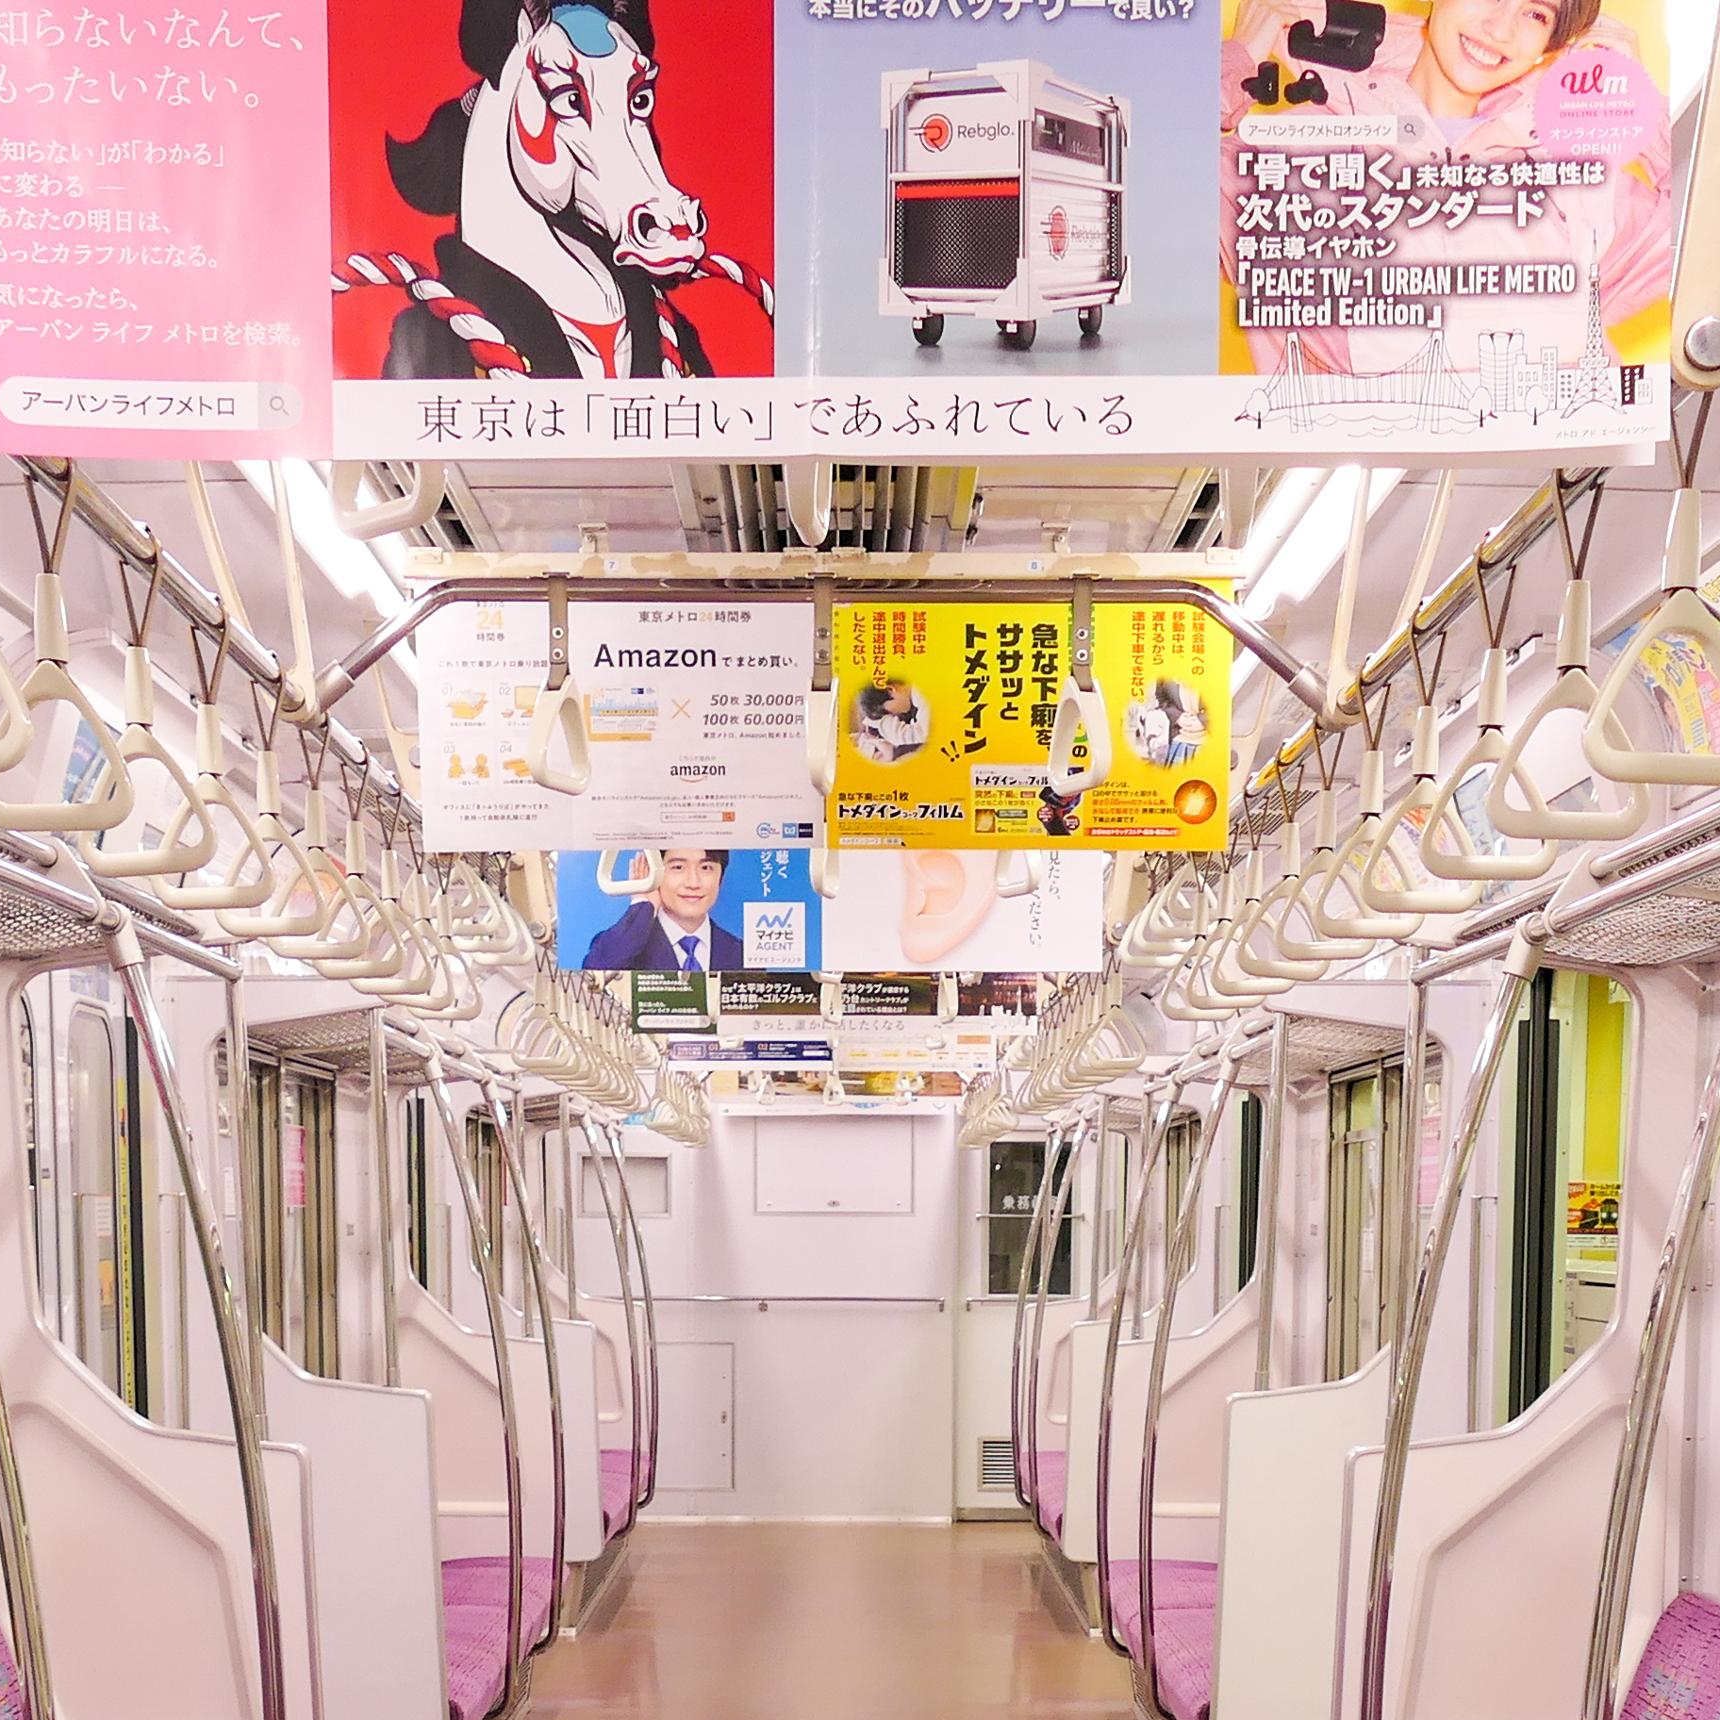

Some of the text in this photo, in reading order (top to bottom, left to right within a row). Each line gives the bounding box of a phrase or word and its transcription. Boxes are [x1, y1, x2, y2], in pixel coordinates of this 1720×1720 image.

[957, 123, 1015, 141] Rebglo.
[1248, 122, 1392, 137] アーバンライフメトロオンライン
[1549, 125, 1643, 140] オンラインストア
[1236, 190, 1547, 232] 次代のスタンダード
[1236, 235, 1397, 261] 骨伝導イヤホン
[1319, 266, 1374, 296] TW-1
[1381, 265, 1451, 295] URBAN
[1456, 264, 1499, 294] LIFE
[1504, 263, 1576, 294] METRO
[1238, 297, 1332, 328] Limited
[92, 321, 154, 344] ライフ
[162, 320, 303, 347] メトロを検索。
[22, 390, 236, 416] アーバンライフメトロ
[476, 609, 505, 631] 24
[912, 610, 927, 655] 試験中は
[1151, 610, 1166, 666] 遅れるから
[593, 643, 717, 668] Amazon
[670, 764, 726, 777] amazon
[755, 929, 794, 941] マイナビ
[755, 941, 794, 951] AGENT
